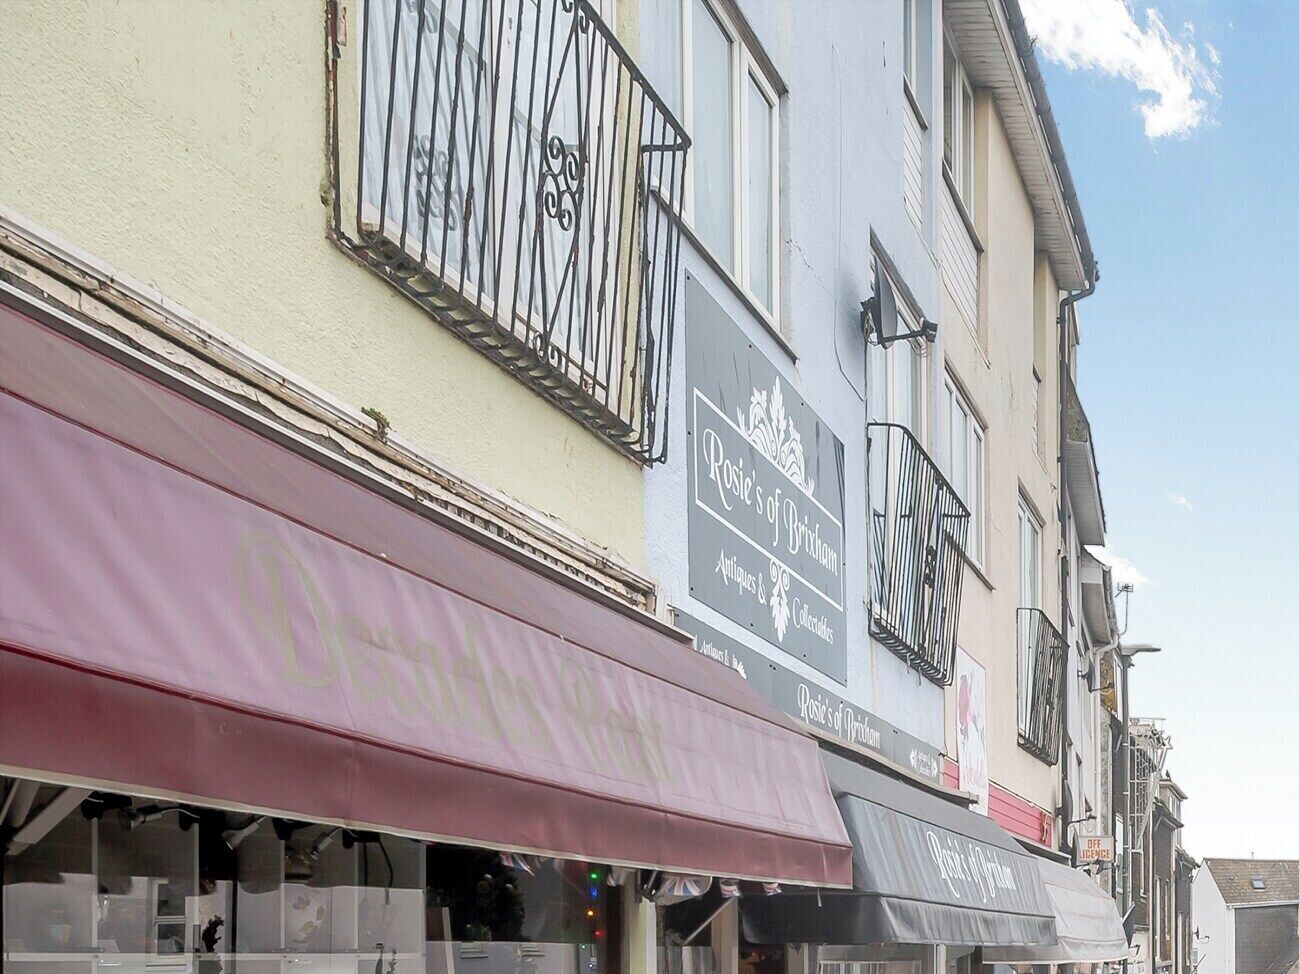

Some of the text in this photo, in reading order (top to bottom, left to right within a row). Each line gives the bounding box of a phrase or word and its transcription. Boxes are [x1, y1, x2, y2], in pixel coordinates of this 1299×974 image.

[702, 428, 838, 577] Rosie's of Brixham
[715, 548, 834, 645] Antiques & Collectables
[237, 532, 551, 751] Decades
[700, 639, 724, 662] Antiques
[797, 683, 881, 749] Rosie's of Brixham
[926, 830, 1017, 904] Rosie's of Brixham
[1080, 849, 1111, 859] LICENCE
[1087, 838, 1101, 849] OFF
